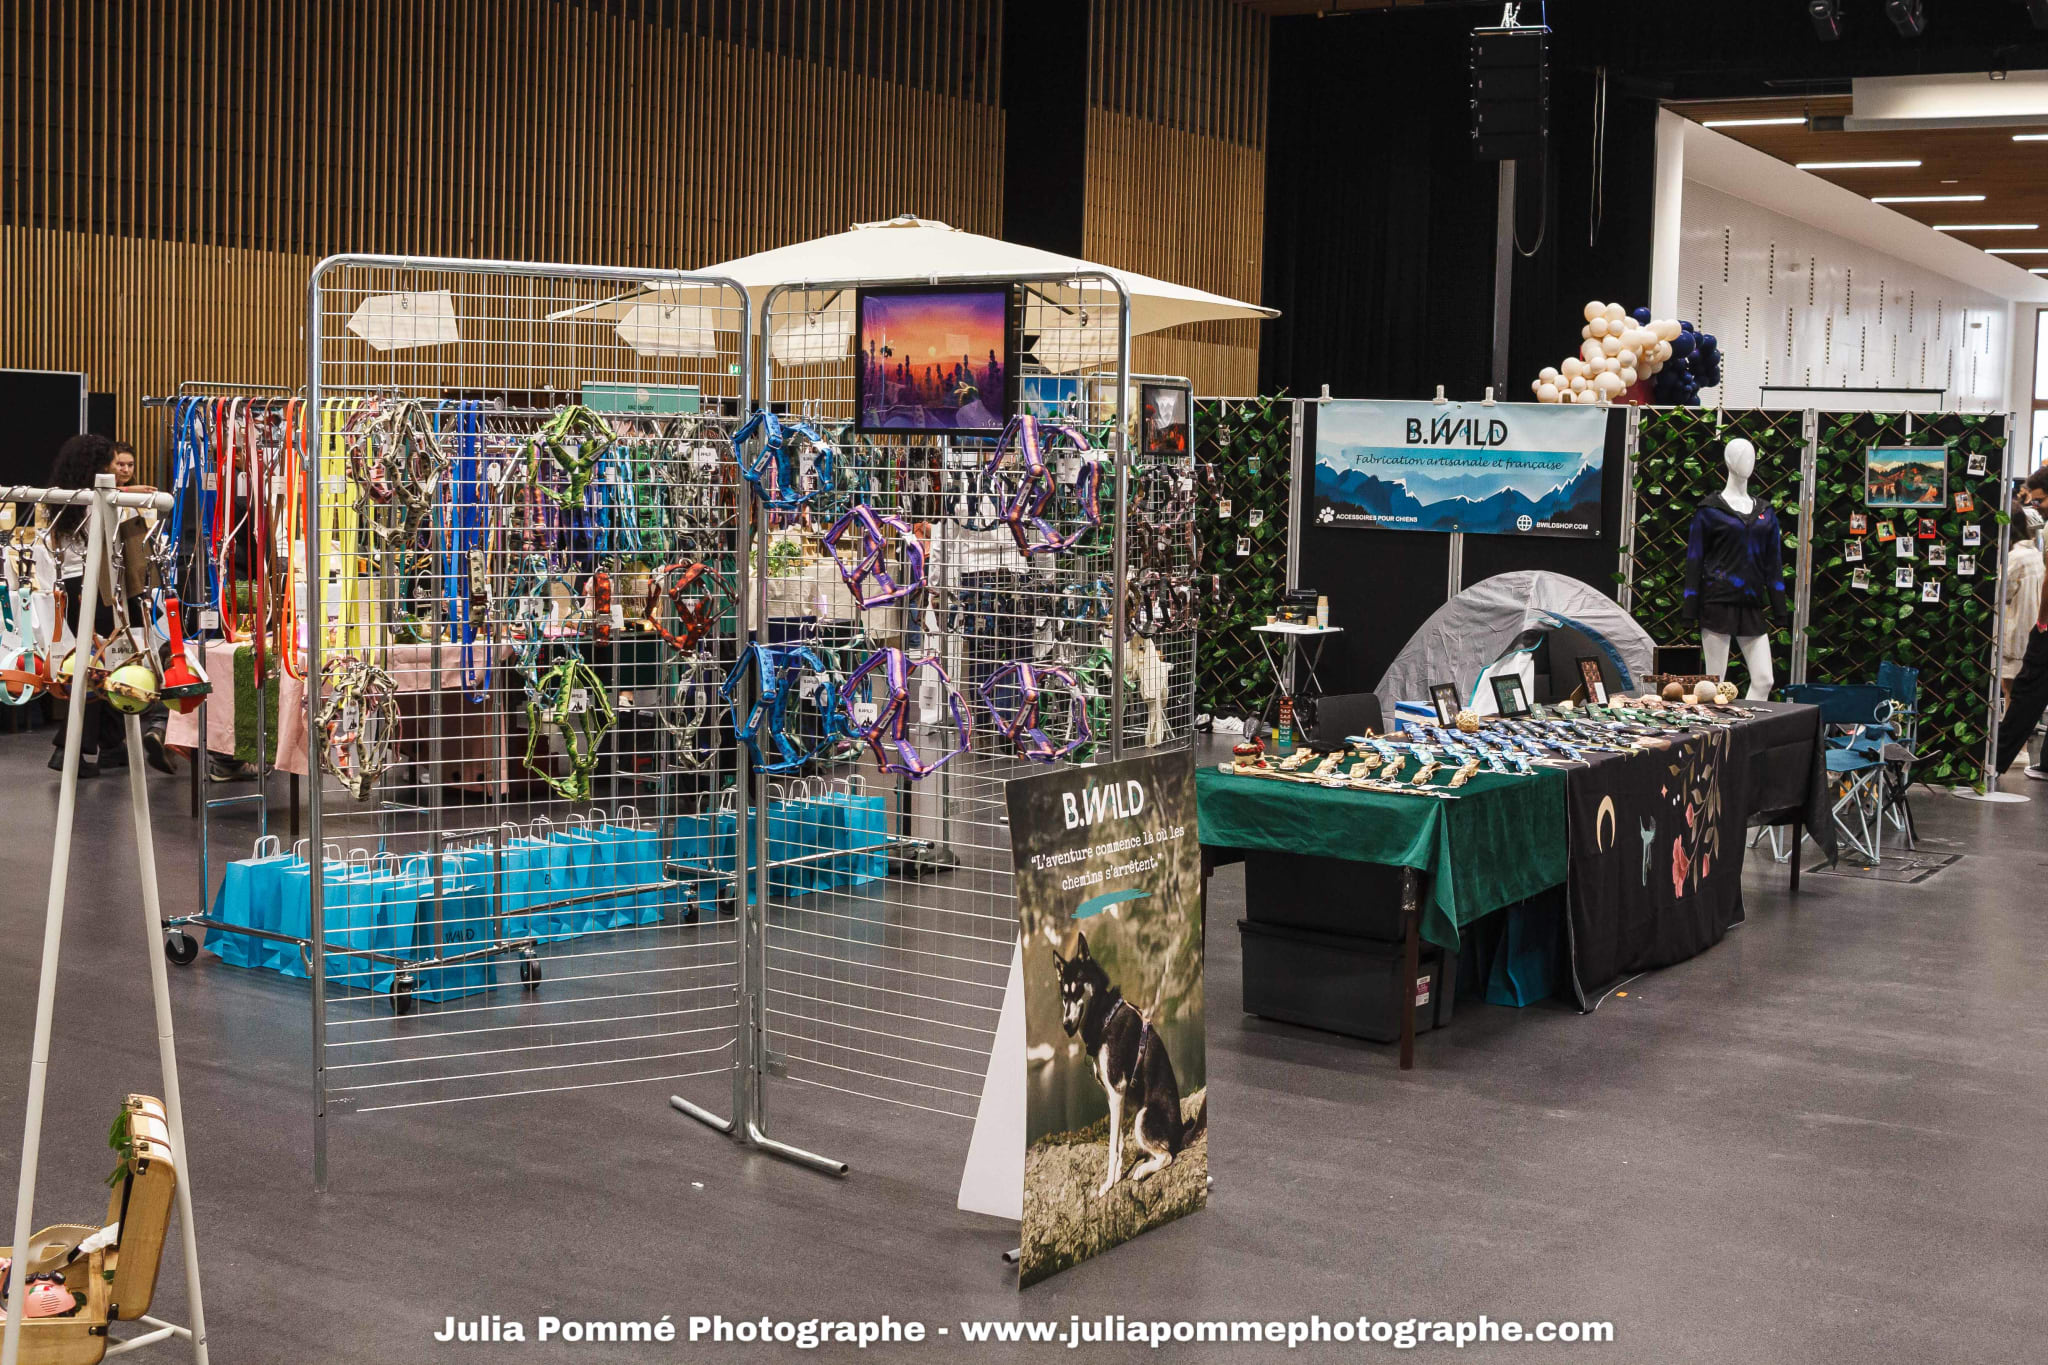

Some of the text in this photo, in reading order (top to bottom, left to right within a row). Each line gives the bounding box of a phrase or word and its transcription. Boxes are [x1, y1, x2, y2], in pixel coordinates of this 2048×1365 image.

[1406, 418, 1508, 446] B.WILD
[1355, 454, 1564, 471] Fabrication artisanale et française
[1336, 513, 1377, 521] ACCESSOIRES
[1536, 521, 1589, 530] BWILDSHOP.COM
[1062, 780, 1144, 830] B.WILD
[1095, 834, 1141, 856] commence
[1143, 831, 1154, 846] là
[1156, 828, 1168, 842] où
[1169, 825, 1185, 840] les
[1061, 869, 1103, 891] chemins
